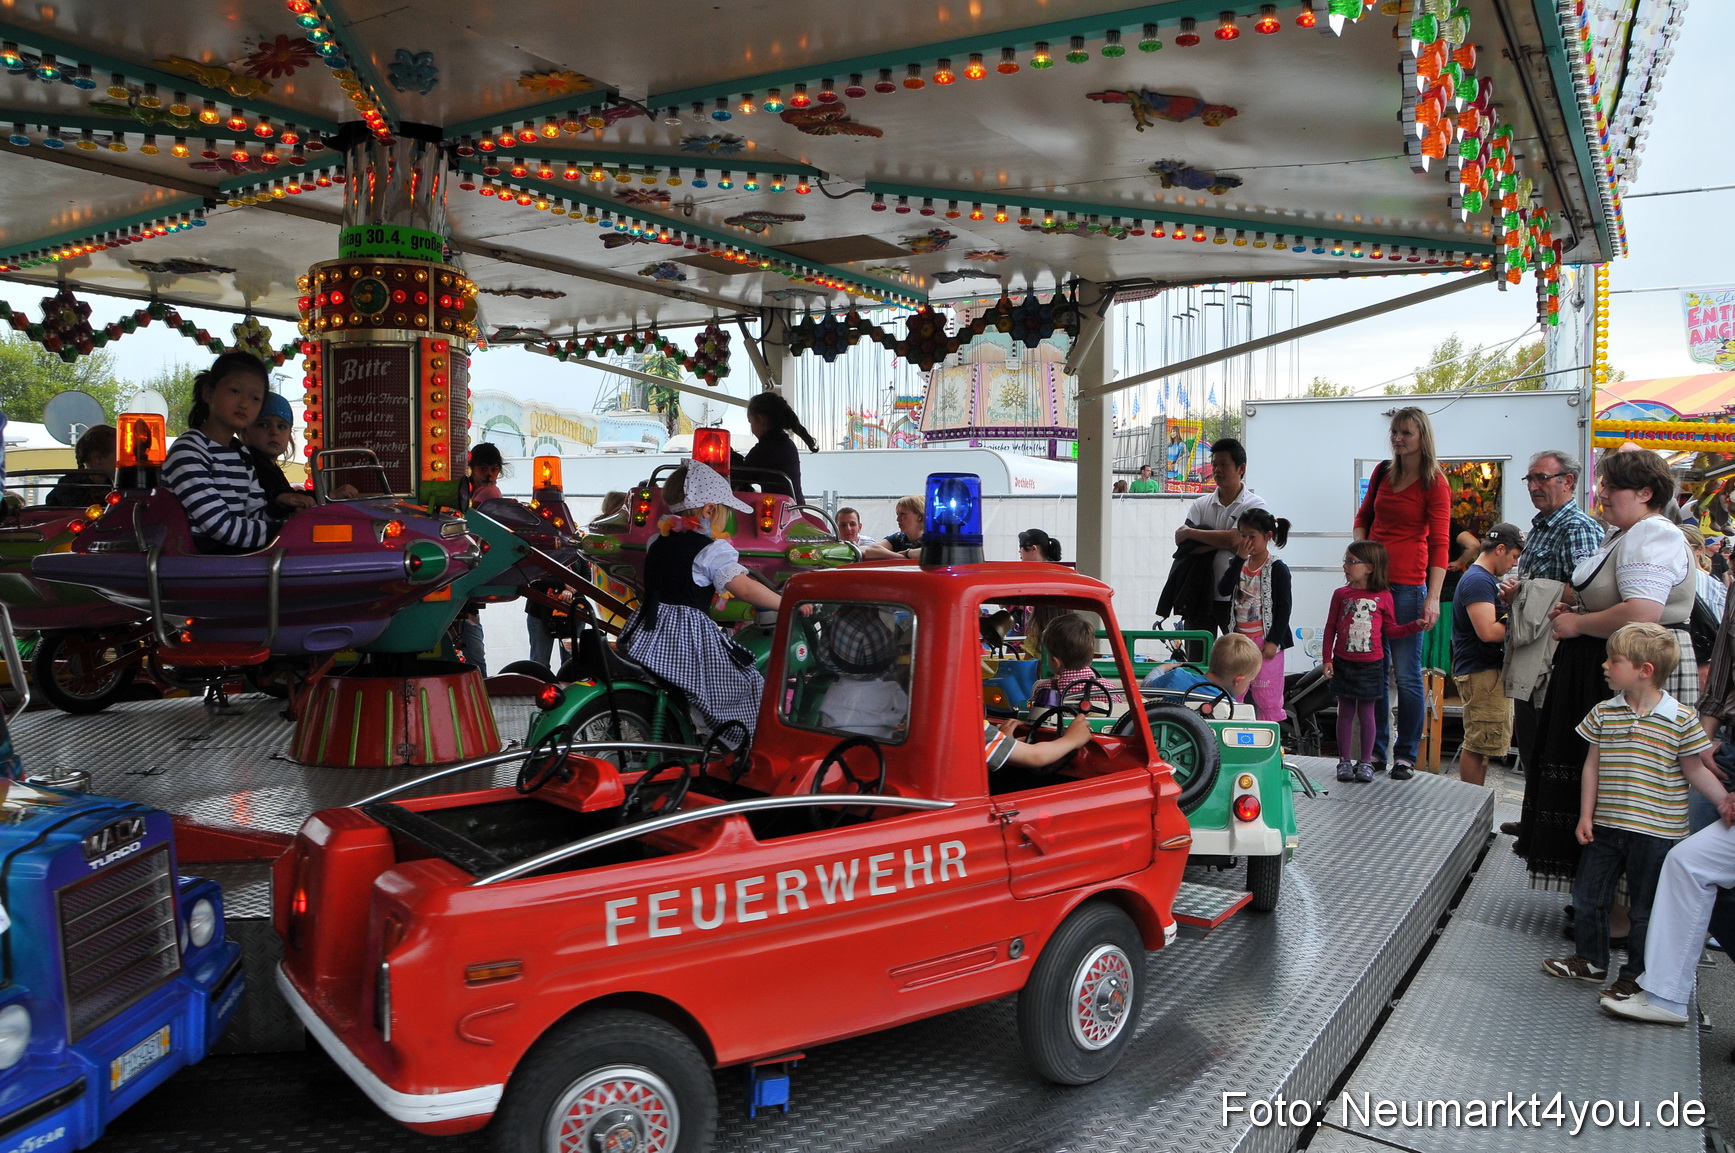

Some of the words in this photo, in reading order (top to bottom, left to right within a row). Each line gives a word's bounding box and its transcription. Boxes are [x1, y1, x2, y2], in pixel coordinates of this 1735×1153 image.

[366, 229, 405, 245] 30.4.
[339, 359, 392, 384] Bitte
[341, 411, 394, 424] Kindern
[339, 429, 372, 440] immer
[1625, 430, 1696, 441] LUSTIGE
[604, 840, 967, 946] FEUERWEHR
